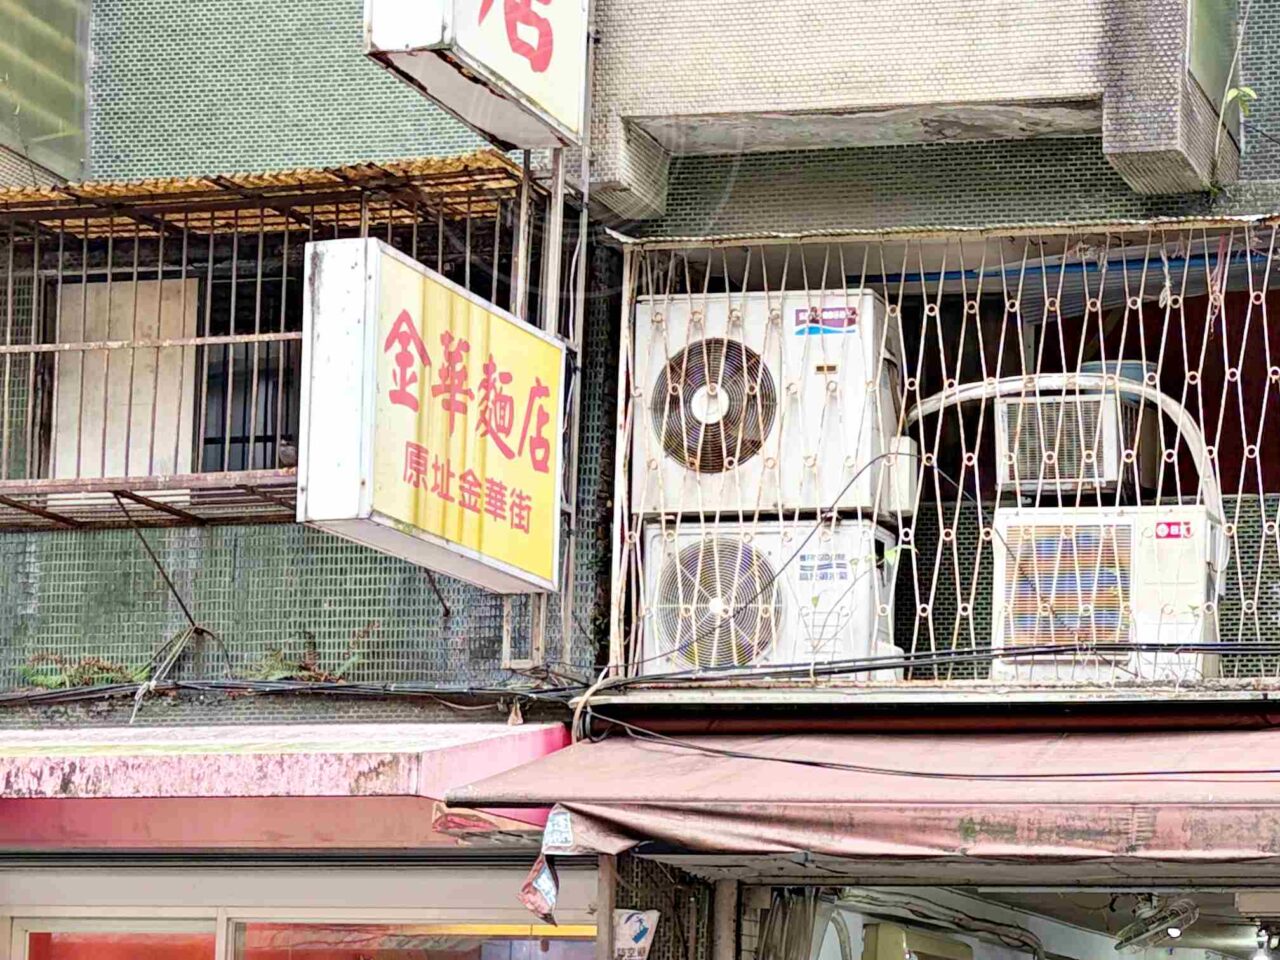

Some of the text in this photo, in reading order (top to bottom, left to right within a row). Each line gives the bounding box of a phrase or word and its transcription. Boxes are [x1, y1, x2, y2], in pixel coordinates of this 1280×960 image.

[384, 308, 550, 474] 金華麵店
[403, 440, 533, 535] 原址金華街
